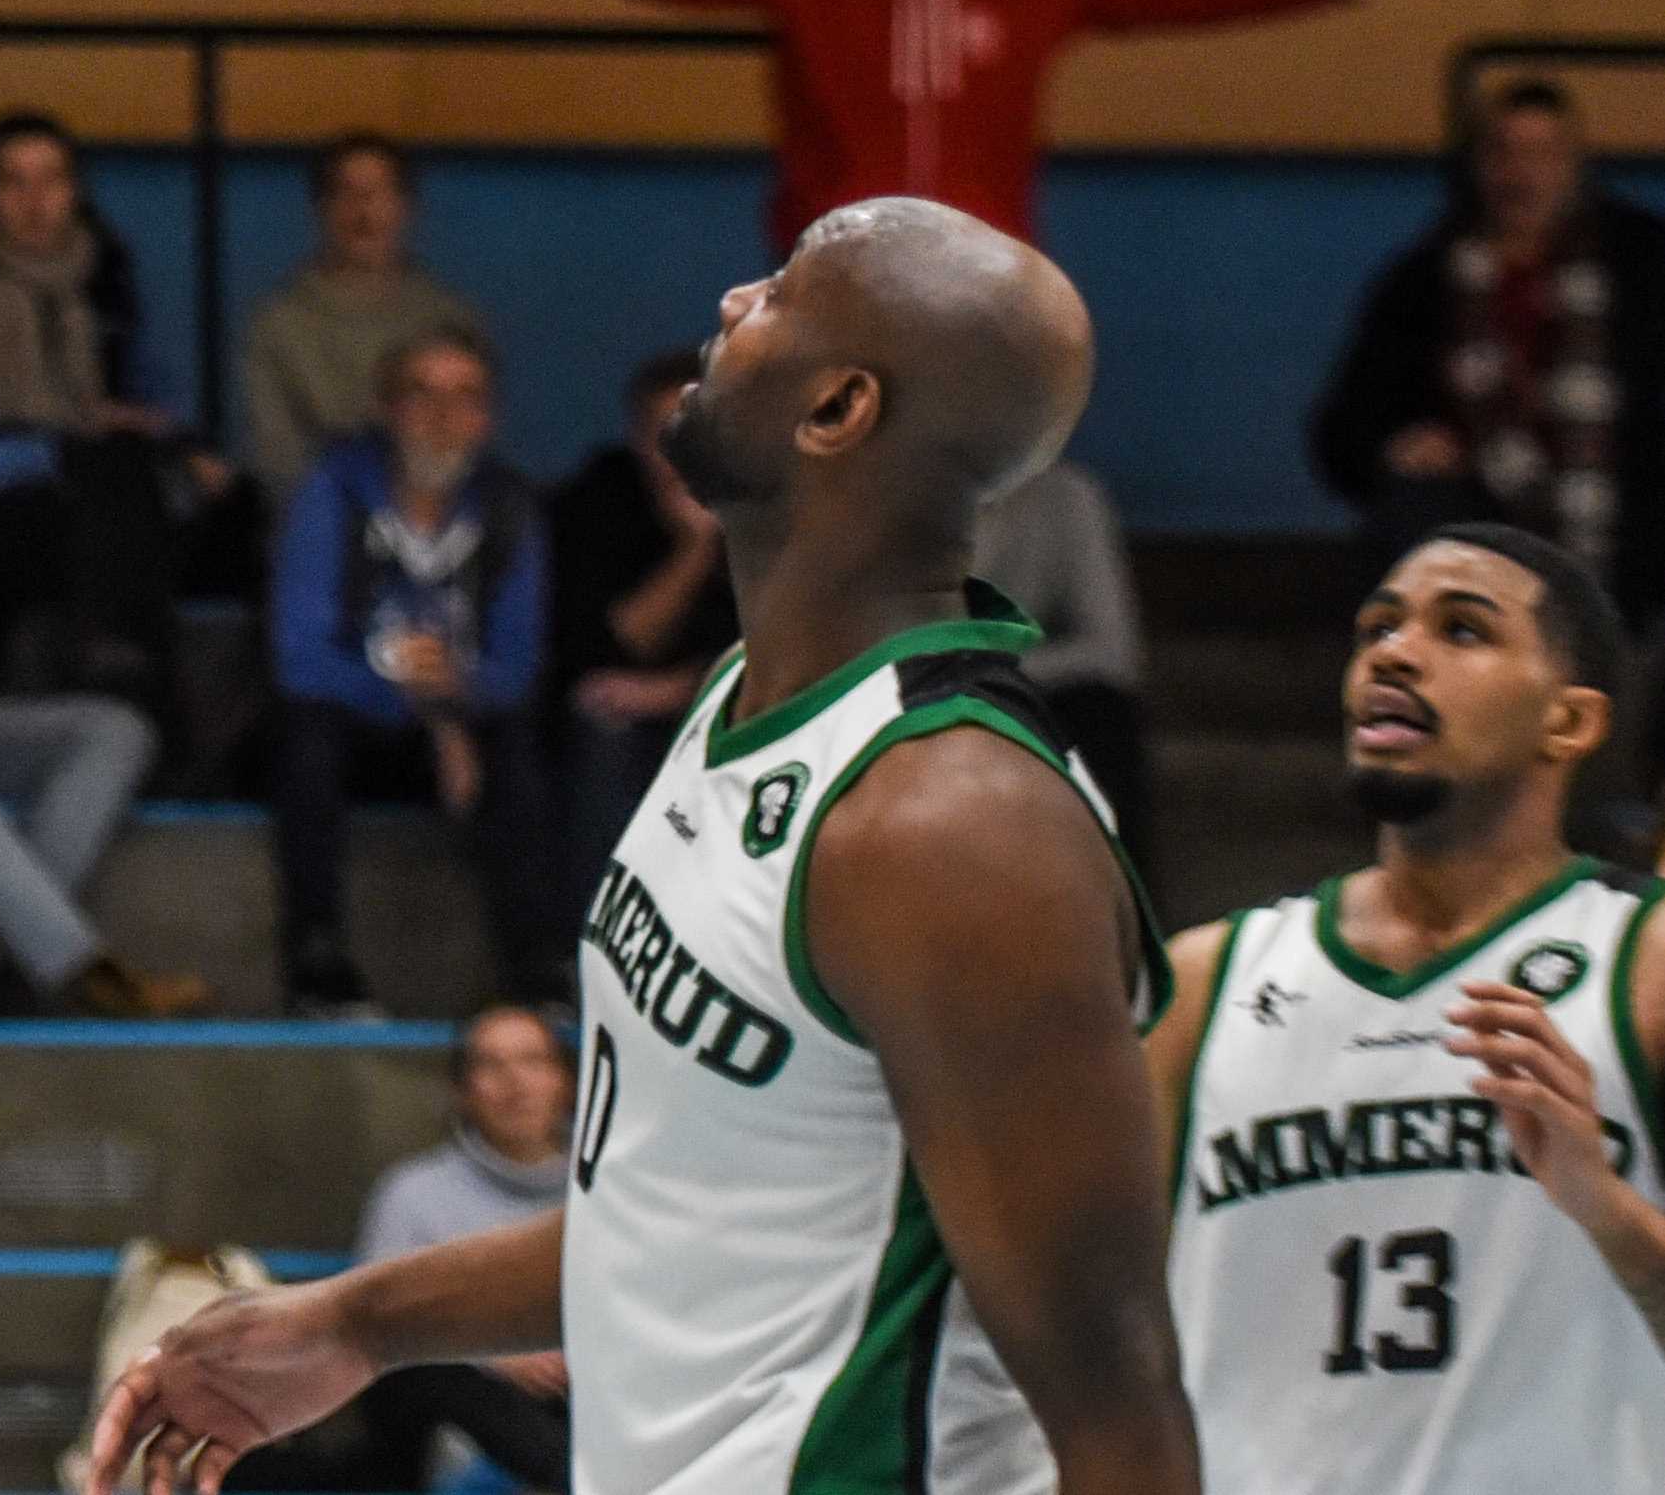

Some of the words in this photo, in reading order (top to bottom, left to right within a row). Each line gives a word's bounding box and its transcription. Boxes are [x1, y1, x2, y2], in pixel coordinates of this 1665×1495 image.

[582, 856, 796, 1089] MERUD
[1196, 1096, 1633, 1211] MMER
[1324, 1227, 1457, 1375] 13
